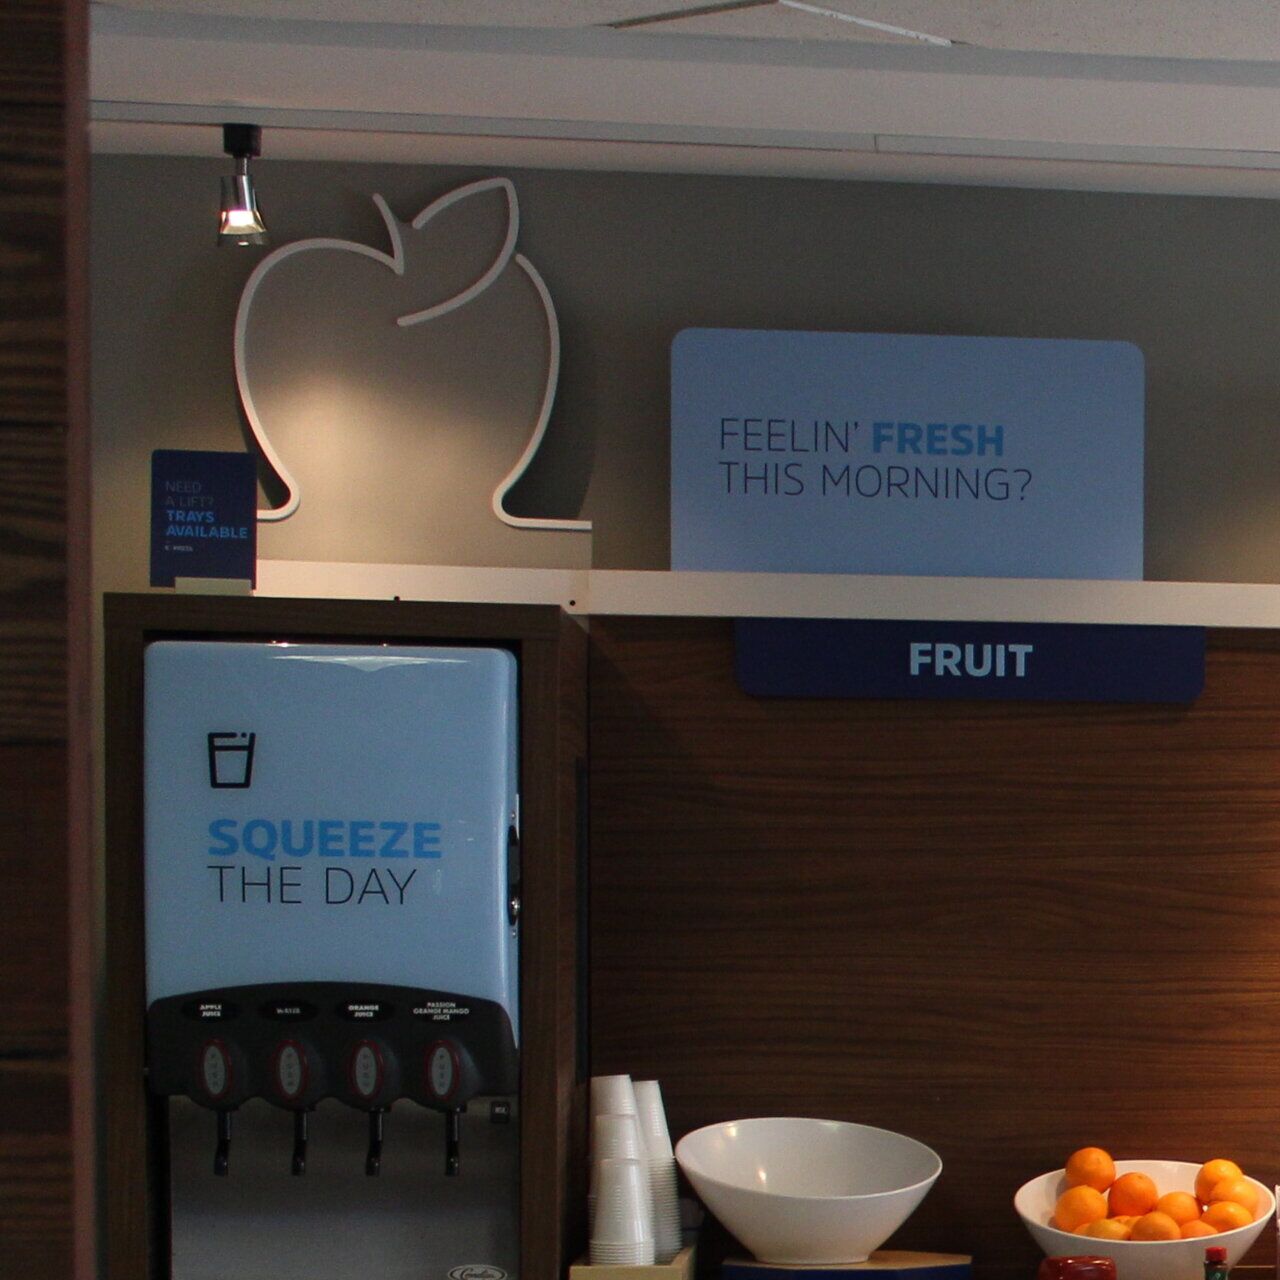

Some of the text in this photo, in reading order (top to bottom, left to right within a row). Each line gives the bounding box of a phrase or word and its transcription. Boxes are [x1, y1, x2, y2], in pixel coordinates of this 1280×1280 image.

[719, 418, 1004, 457] FEELIN' FRESH
[718, 461, 1034, 501] THIS MORNING?
[166, 510, 216, 523] TRAYS
[166, 525, 250, 539] AVAILABLE
[908, 641, 1034, 678] FRUIT
[207, 818, 443, 861] SQUEEZE
[206, 865, 417, 906] THE DAY
[199, 1003, 223, 1011] APPLE
